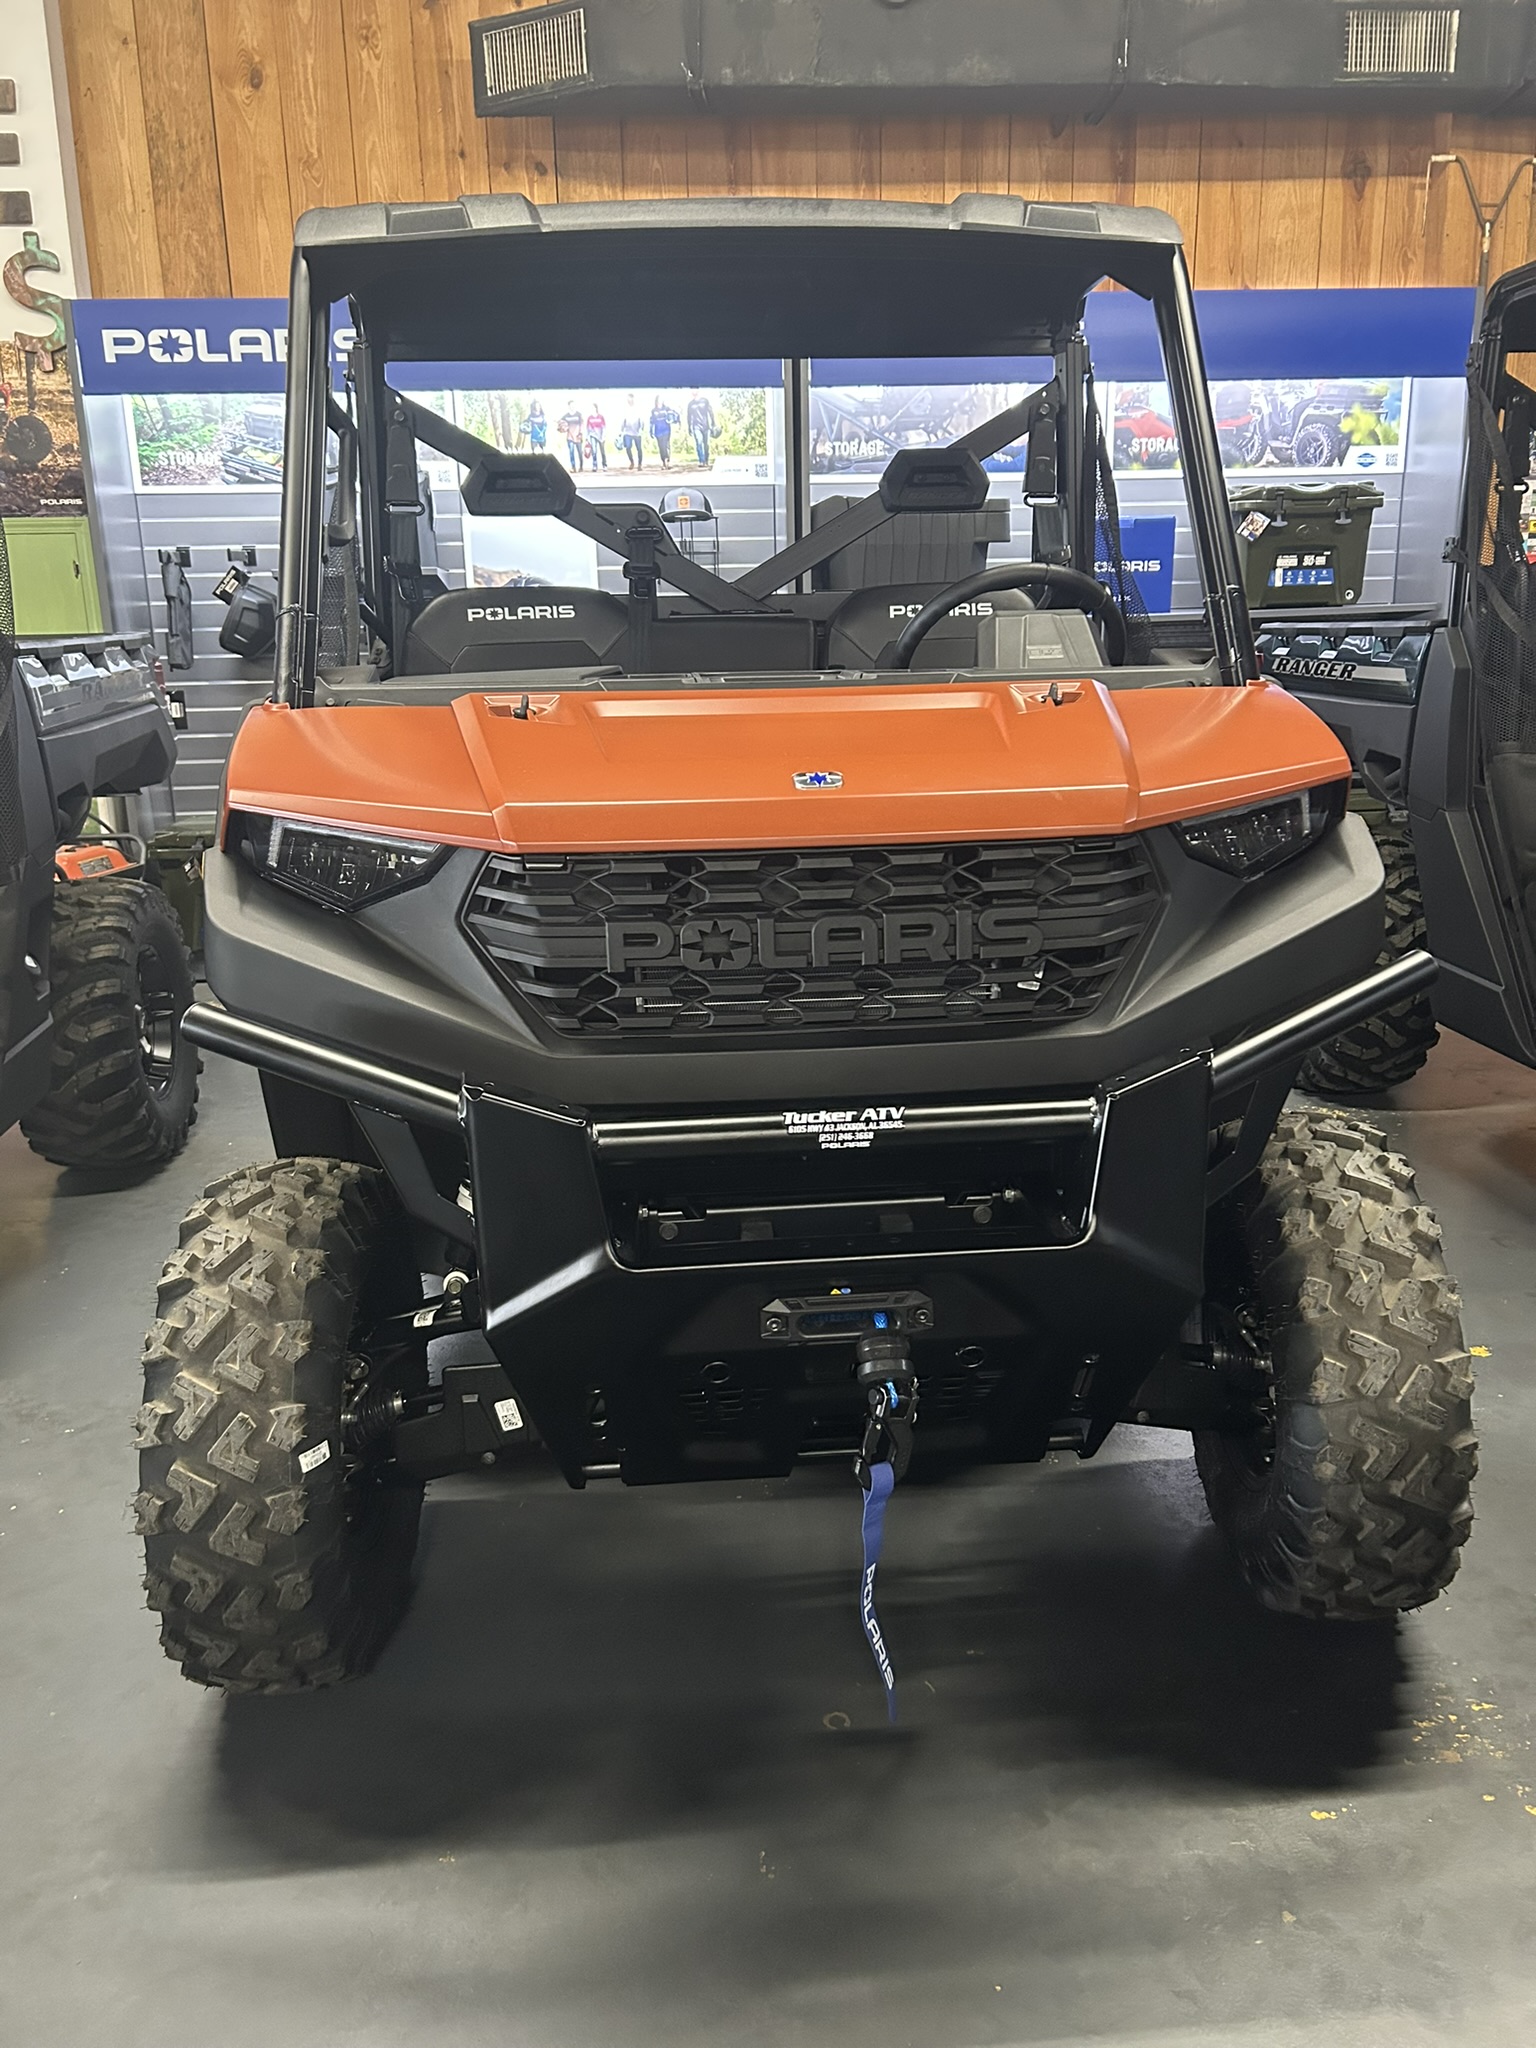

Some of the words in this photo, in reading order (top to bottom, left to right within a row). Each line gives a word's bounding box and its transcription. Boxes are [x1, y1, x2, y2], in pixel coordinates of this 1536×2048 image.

[825, 439, 885, 457] STORAGE
[40, 498, 83, 506] POLARIS
[467, 604, 576, 622] POLARIS
[1273, 655, 1358, 681] RANGER
[605, 904, 1044, 973] POLARIS
[782, 1110, 858, 1125] Tucker
[859, 1106, 906, 1121] ATV
[821, 1140, 871, 1149] POLARIS
[863, 1562, 895, 1691] POLARIS
